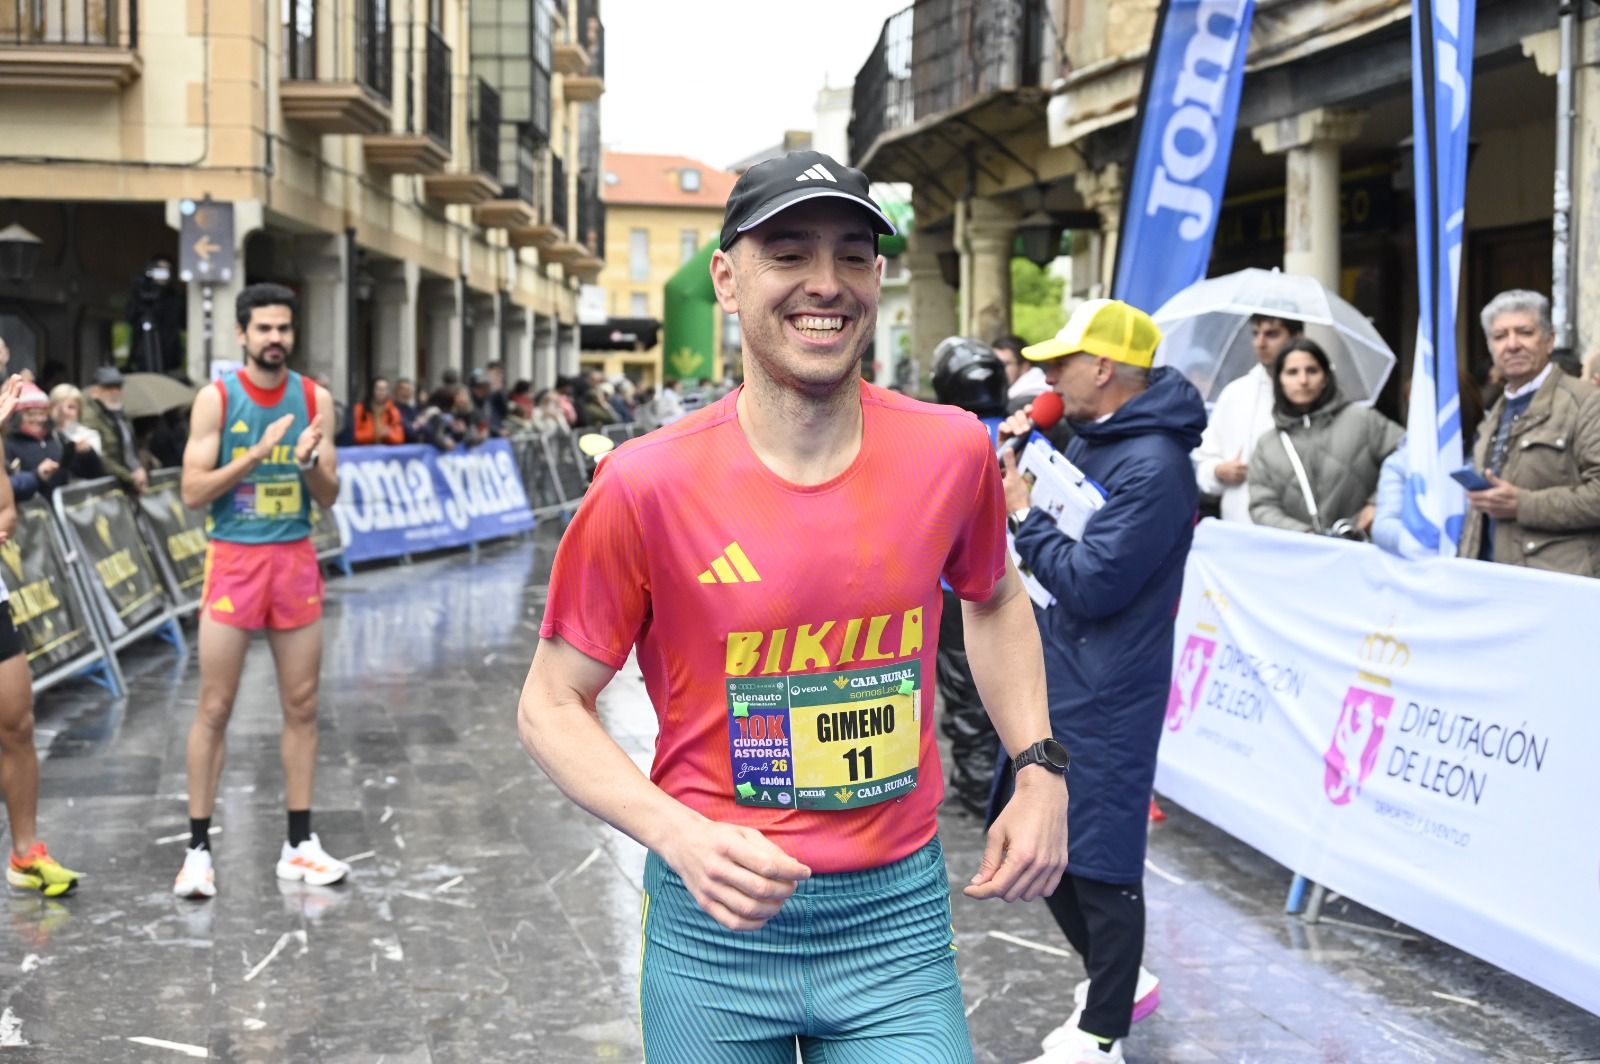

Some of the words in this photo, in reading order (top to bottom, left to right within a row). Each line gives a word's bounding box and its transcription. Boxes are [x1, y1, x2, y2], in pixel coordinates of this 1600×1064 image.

[725, 606, 923, 676] BIKILA
[801, 685, 828, 693] VEOLIA
[850, 676, 878, 689] CAJA
[881, 668, 914, 684] RURAL
[730, 693, 782, 702] Telenauto
[735, 714, 785, 740] 10K
[816, 704, 895, 743] GIMENO
[733, 738, 773, 747] CIUDAD
[775, 738, 789, 747] DE
[1400, 701, 1548, 772] DIPUTACIÓN
[734, 748, 791, 758] ASTORGA
[842, 746, 873, 782] 11
[771, 759, 788, 772] 26
[1387, 745, 1419, 782] DE
[1420, 754, 1487, 805] LEÓN
[760, 776, 784, 786] CAJÓN
[785, 777, 792, 786] A
[857, 787, 882, 799] CAJA
[885, 774, 914, 792] RURAL
